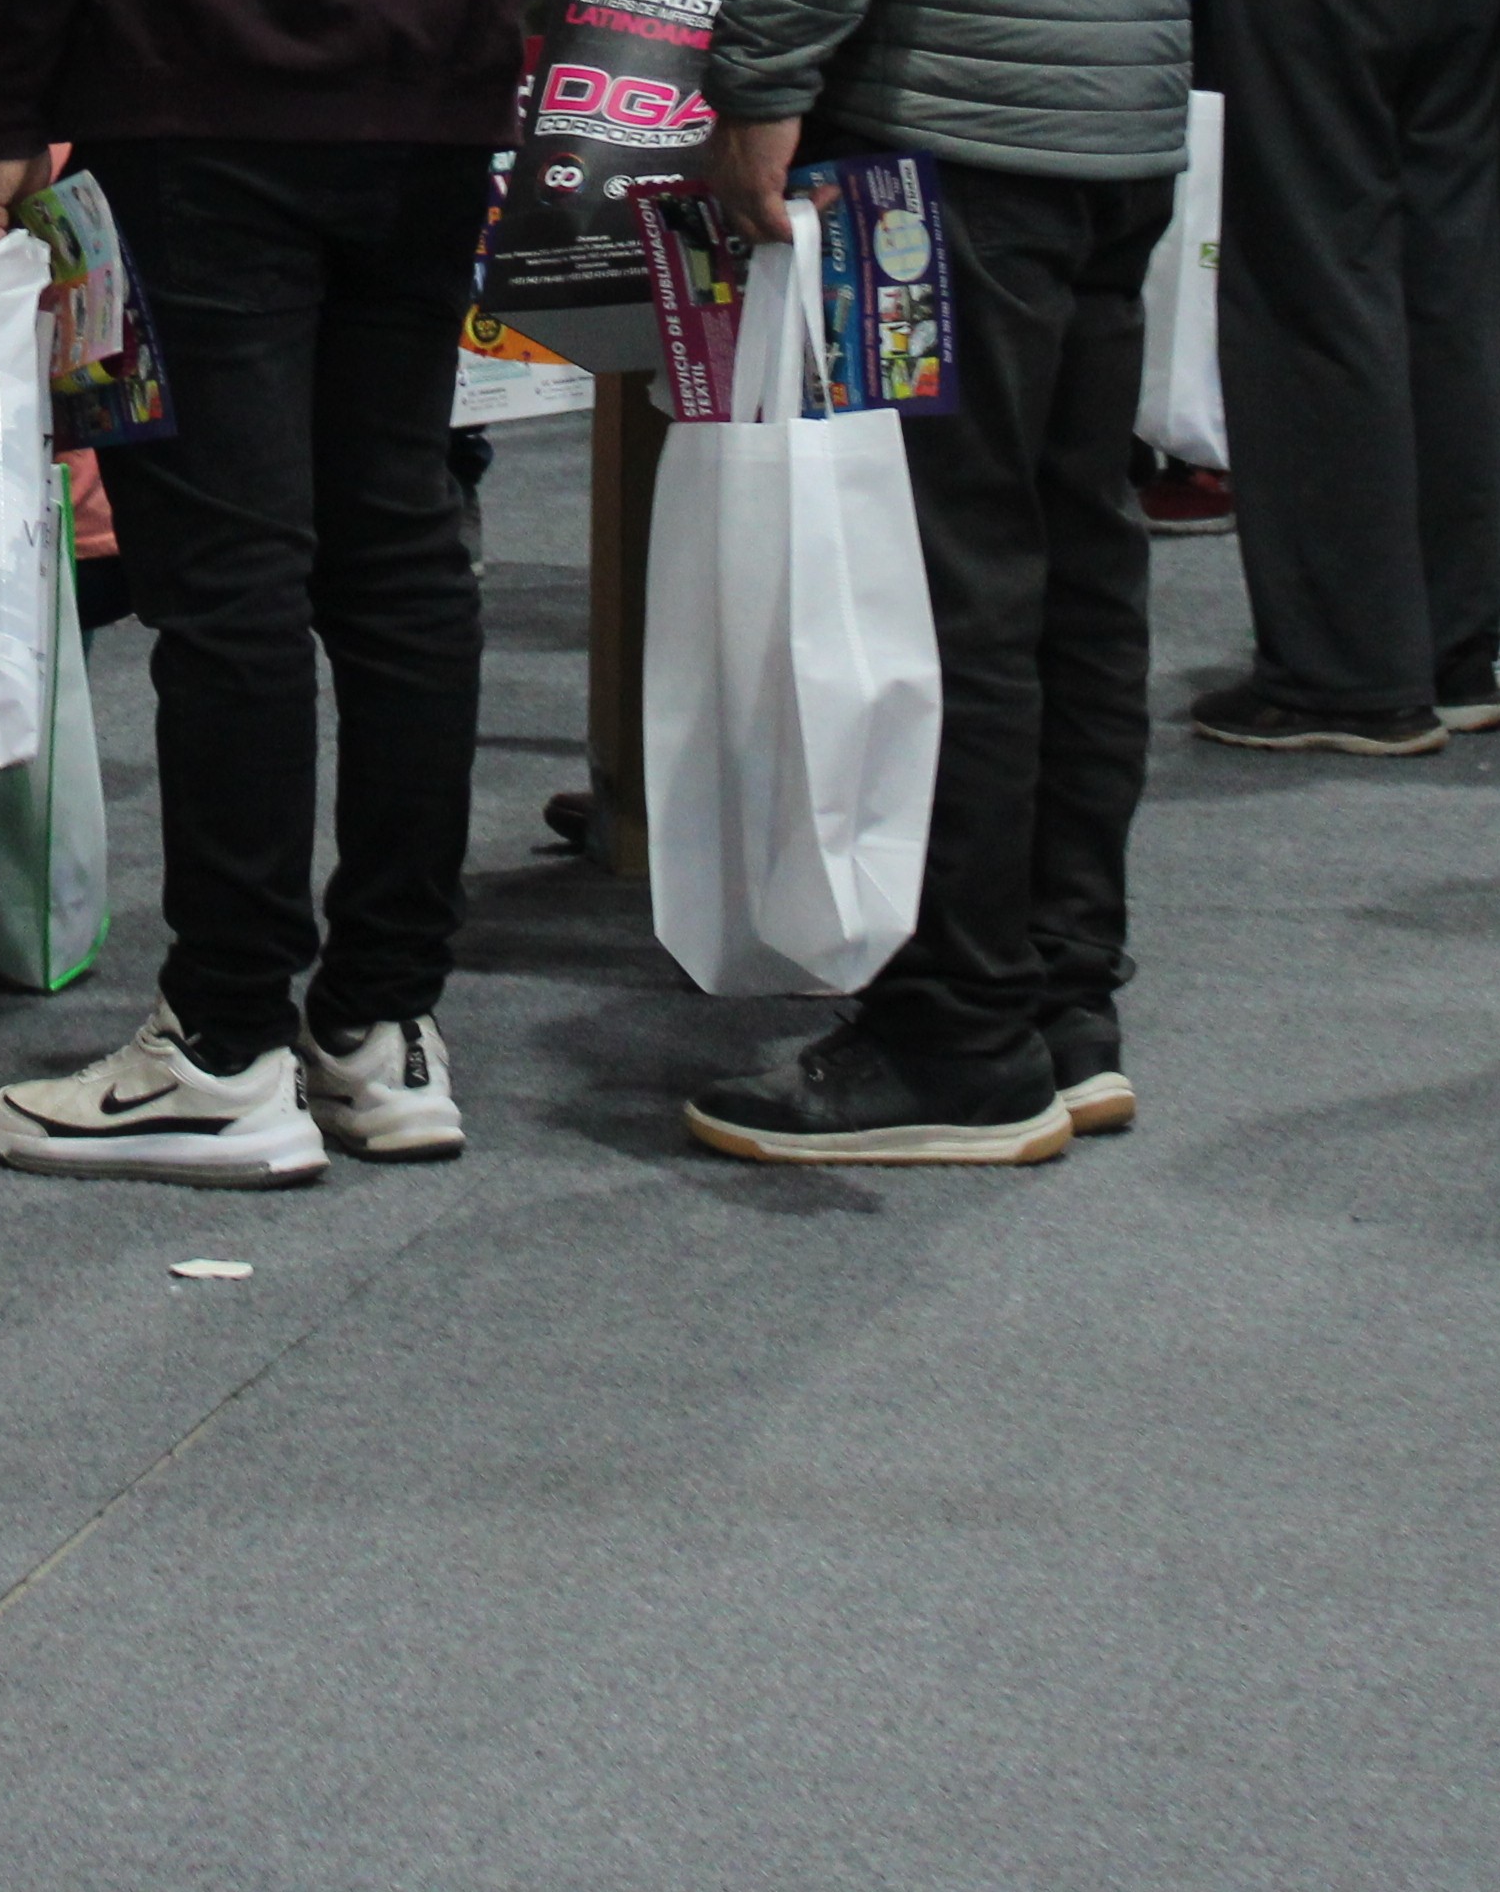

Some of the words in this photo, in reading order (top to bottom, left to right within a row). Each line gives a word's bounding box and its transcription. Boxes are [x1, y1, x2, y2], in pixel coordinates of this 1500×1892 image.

[637, 1, 654, 16] DE
[540, 62, 719, 129] DGA
[638, 197, 680, 310] SUBLIMACION
[665, 312, 684, 338] DE
[672, 341, 700, 417] SERVICIO
[690, 362, 714, 416] TEXTIL
